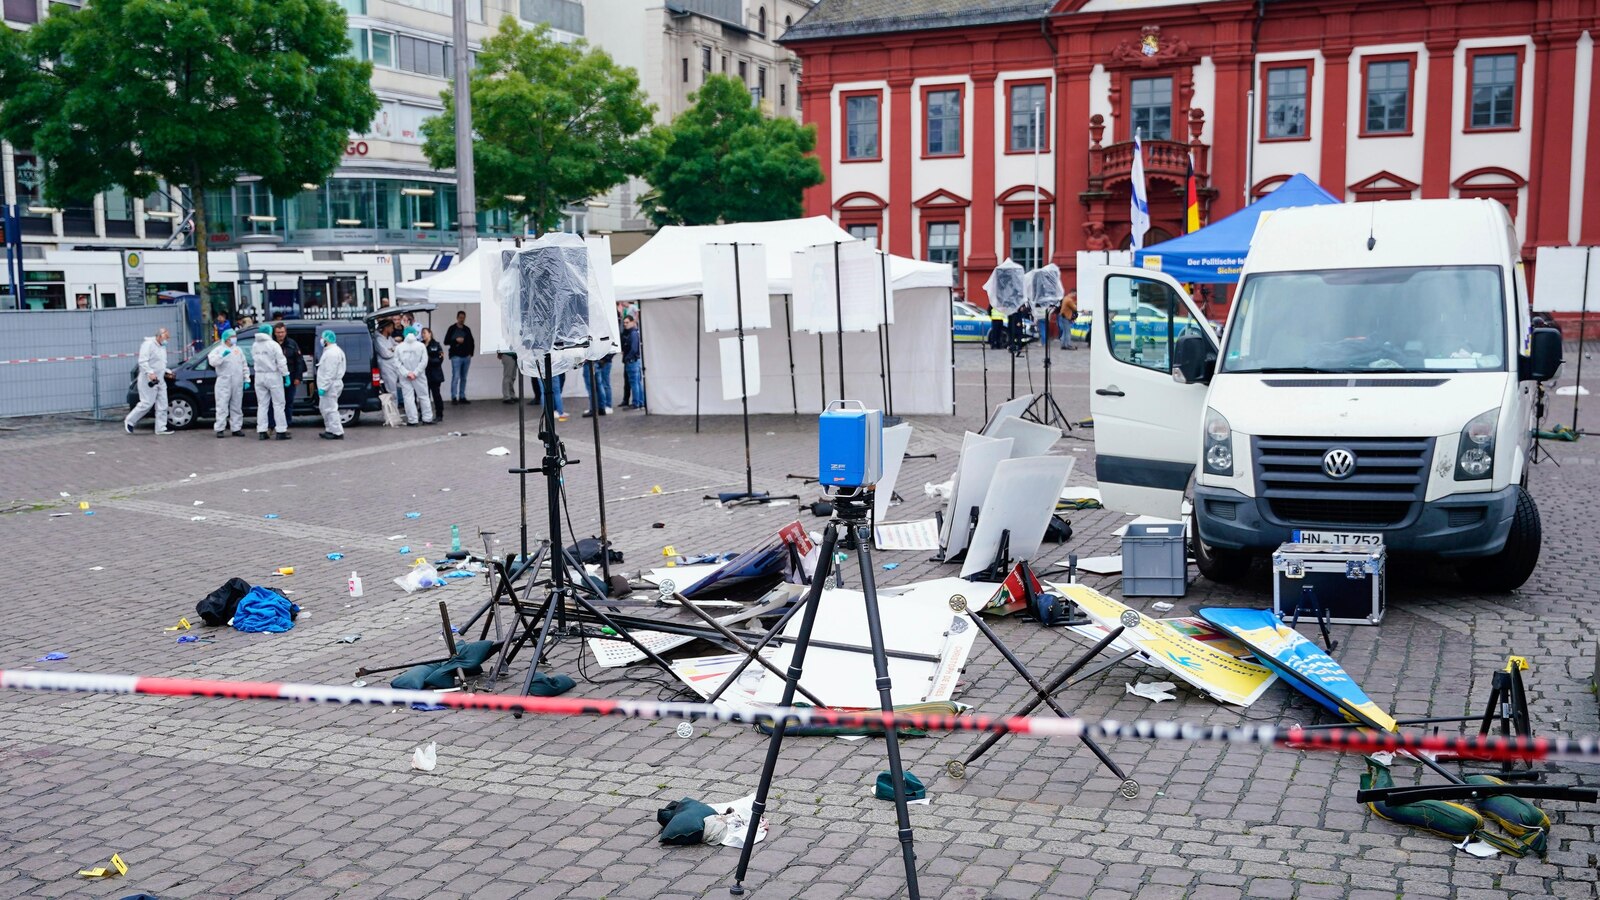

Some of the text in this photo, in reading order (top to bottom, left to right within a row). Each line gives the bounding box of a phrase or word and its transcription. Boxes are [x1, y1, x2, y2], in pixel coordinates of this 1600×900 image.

[344, 141, 369, 156] GO
[1187, 258, 1200, 266] Der
[1202, 257, 1236, 266] Politische
[1209, 652, 1267, 674] Normen
